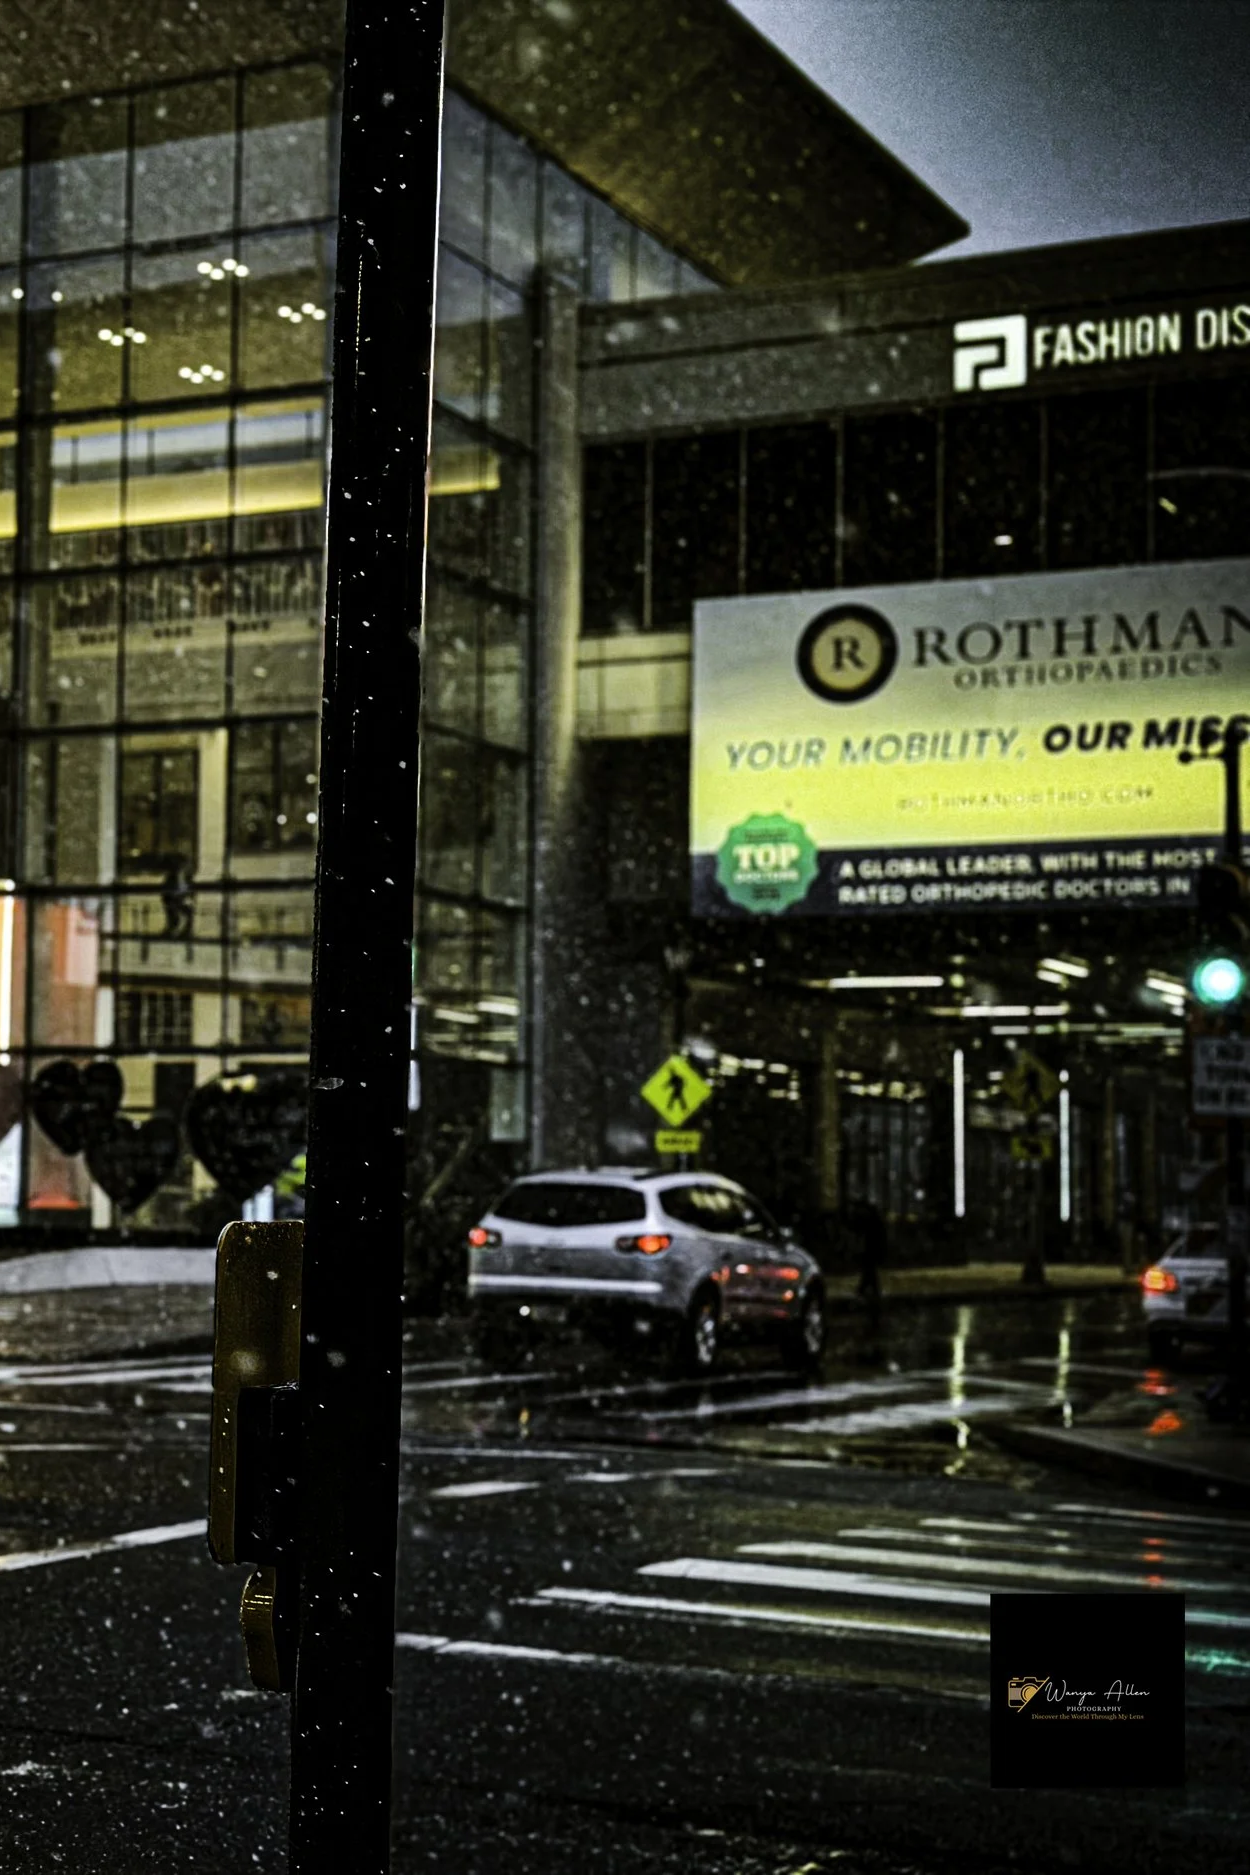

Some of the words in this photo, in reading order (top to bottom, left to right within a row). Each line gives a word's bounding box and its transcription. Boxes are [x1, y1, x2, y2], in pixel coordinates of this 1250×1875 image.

[1033, 311, 1182, 370] FASHION
[1196, 303, 1250, 350] DIS
[830, 635, 869, 673] R
[953, 652, 1225, 692] ORTHOPAEDICS
[725, 736, 827, 772] YOUR
[838, 726, 1027, 768] MOBILITY,
[1042, 722, 1134, 754] OUR
[732, 842, 801, 872] TOP
[839, 859, 856, 880] A
[858, 856, 940, 881] GLOBAL
[1040, 850, 1099, 873] WITH
[1104, 849, 1146, 871] THE
[1152, 847, 1216, 869] MOST
[838, 884, 907, 905] RATED
[910, 878, 1049, 903] ORTHOPEDIC
[1053, 875, 1161, 899] DOCTORS
[1166, 875, 1191, 895] IN
